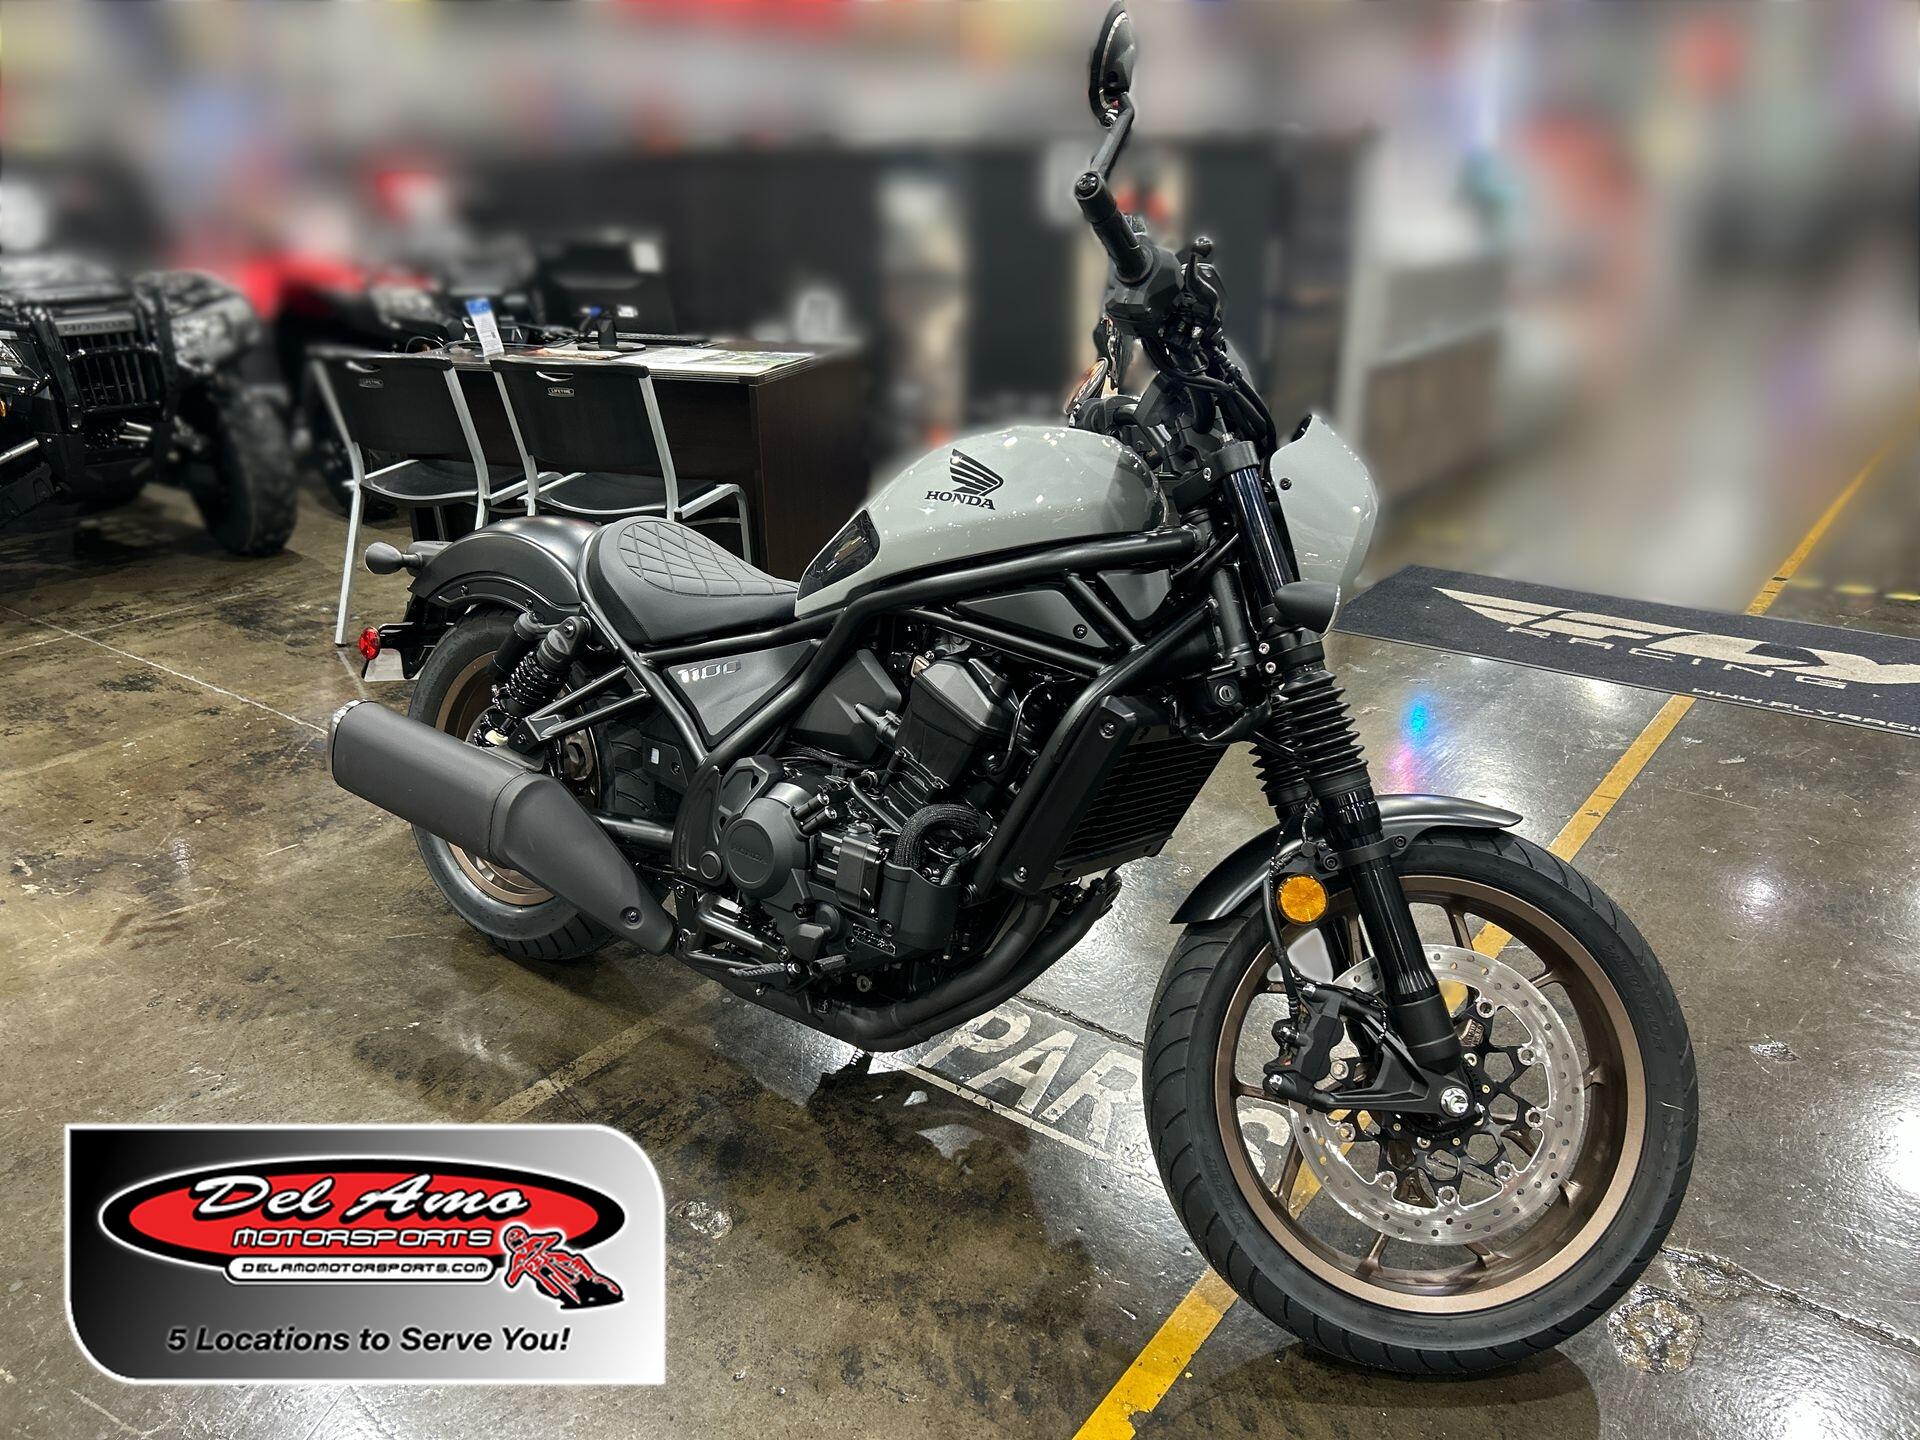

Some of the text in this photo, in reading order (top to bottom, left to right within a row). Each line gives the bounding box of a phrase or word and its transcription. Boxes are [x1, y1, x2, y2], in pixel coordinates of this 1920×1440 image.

[925, 491, 996, 510] HONDA
[1506, 626, 1847, 690] RACING
[677, 660, 741, 683] 1100
